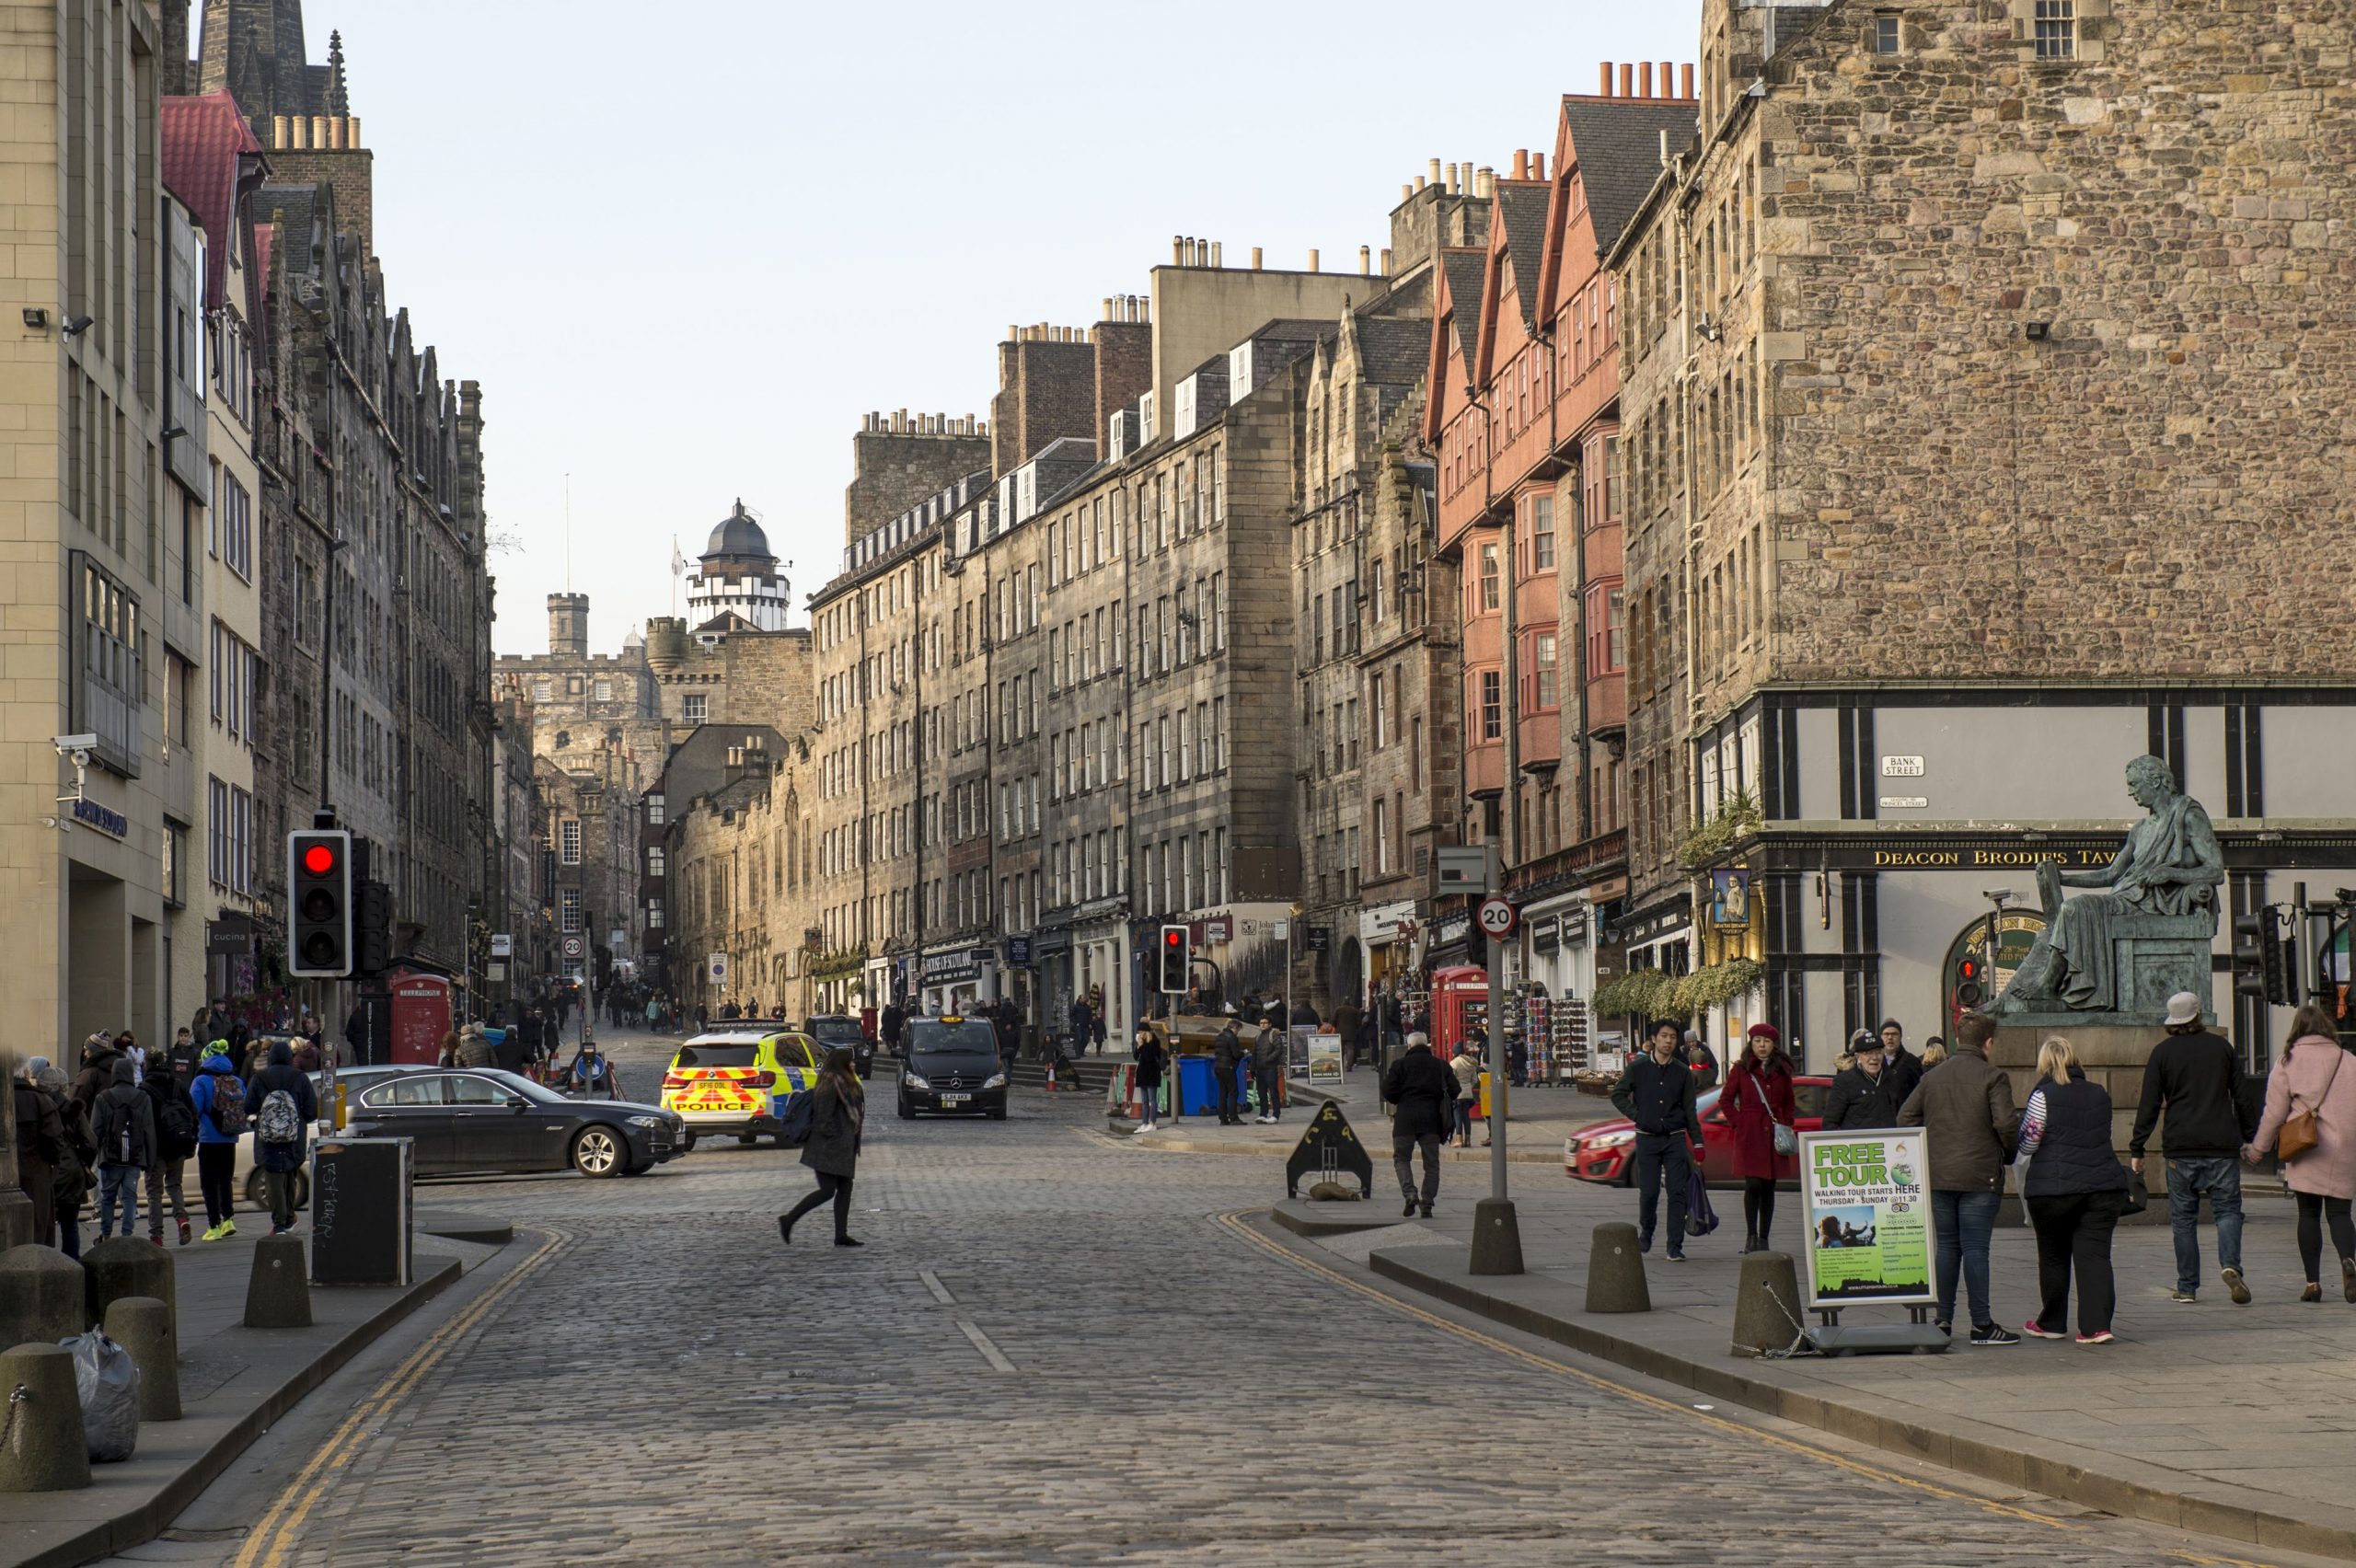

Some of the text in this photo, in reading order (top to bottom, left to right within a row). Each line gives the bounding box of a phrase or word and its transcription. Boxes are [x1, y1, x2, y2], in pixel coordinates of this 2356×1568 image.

[1890, 757, 1916, 766] BANK
[1886, 766, 1921, 775] STREET
[1874, 850, 2118, 865] DEACON BRODIE'S TAV
[1484, 909, 1509, 925] 20
[214, 931, 246, 940] cucina
[567, 942, 579, 951] 20
[926, 951, 972, 974] HOUSE OF SCOTLAND
[1814, 1142, 1886, 1167] FREE
[1813, 1164, 1889, 1188] TOUR
[1814, 1183, 1921, 1197] WALKING TOUR STARTS HERE
[1819, 1197, 1855, 1205] THURSDAY
[1861, 1195, 1888, 1205] SUNDAY
